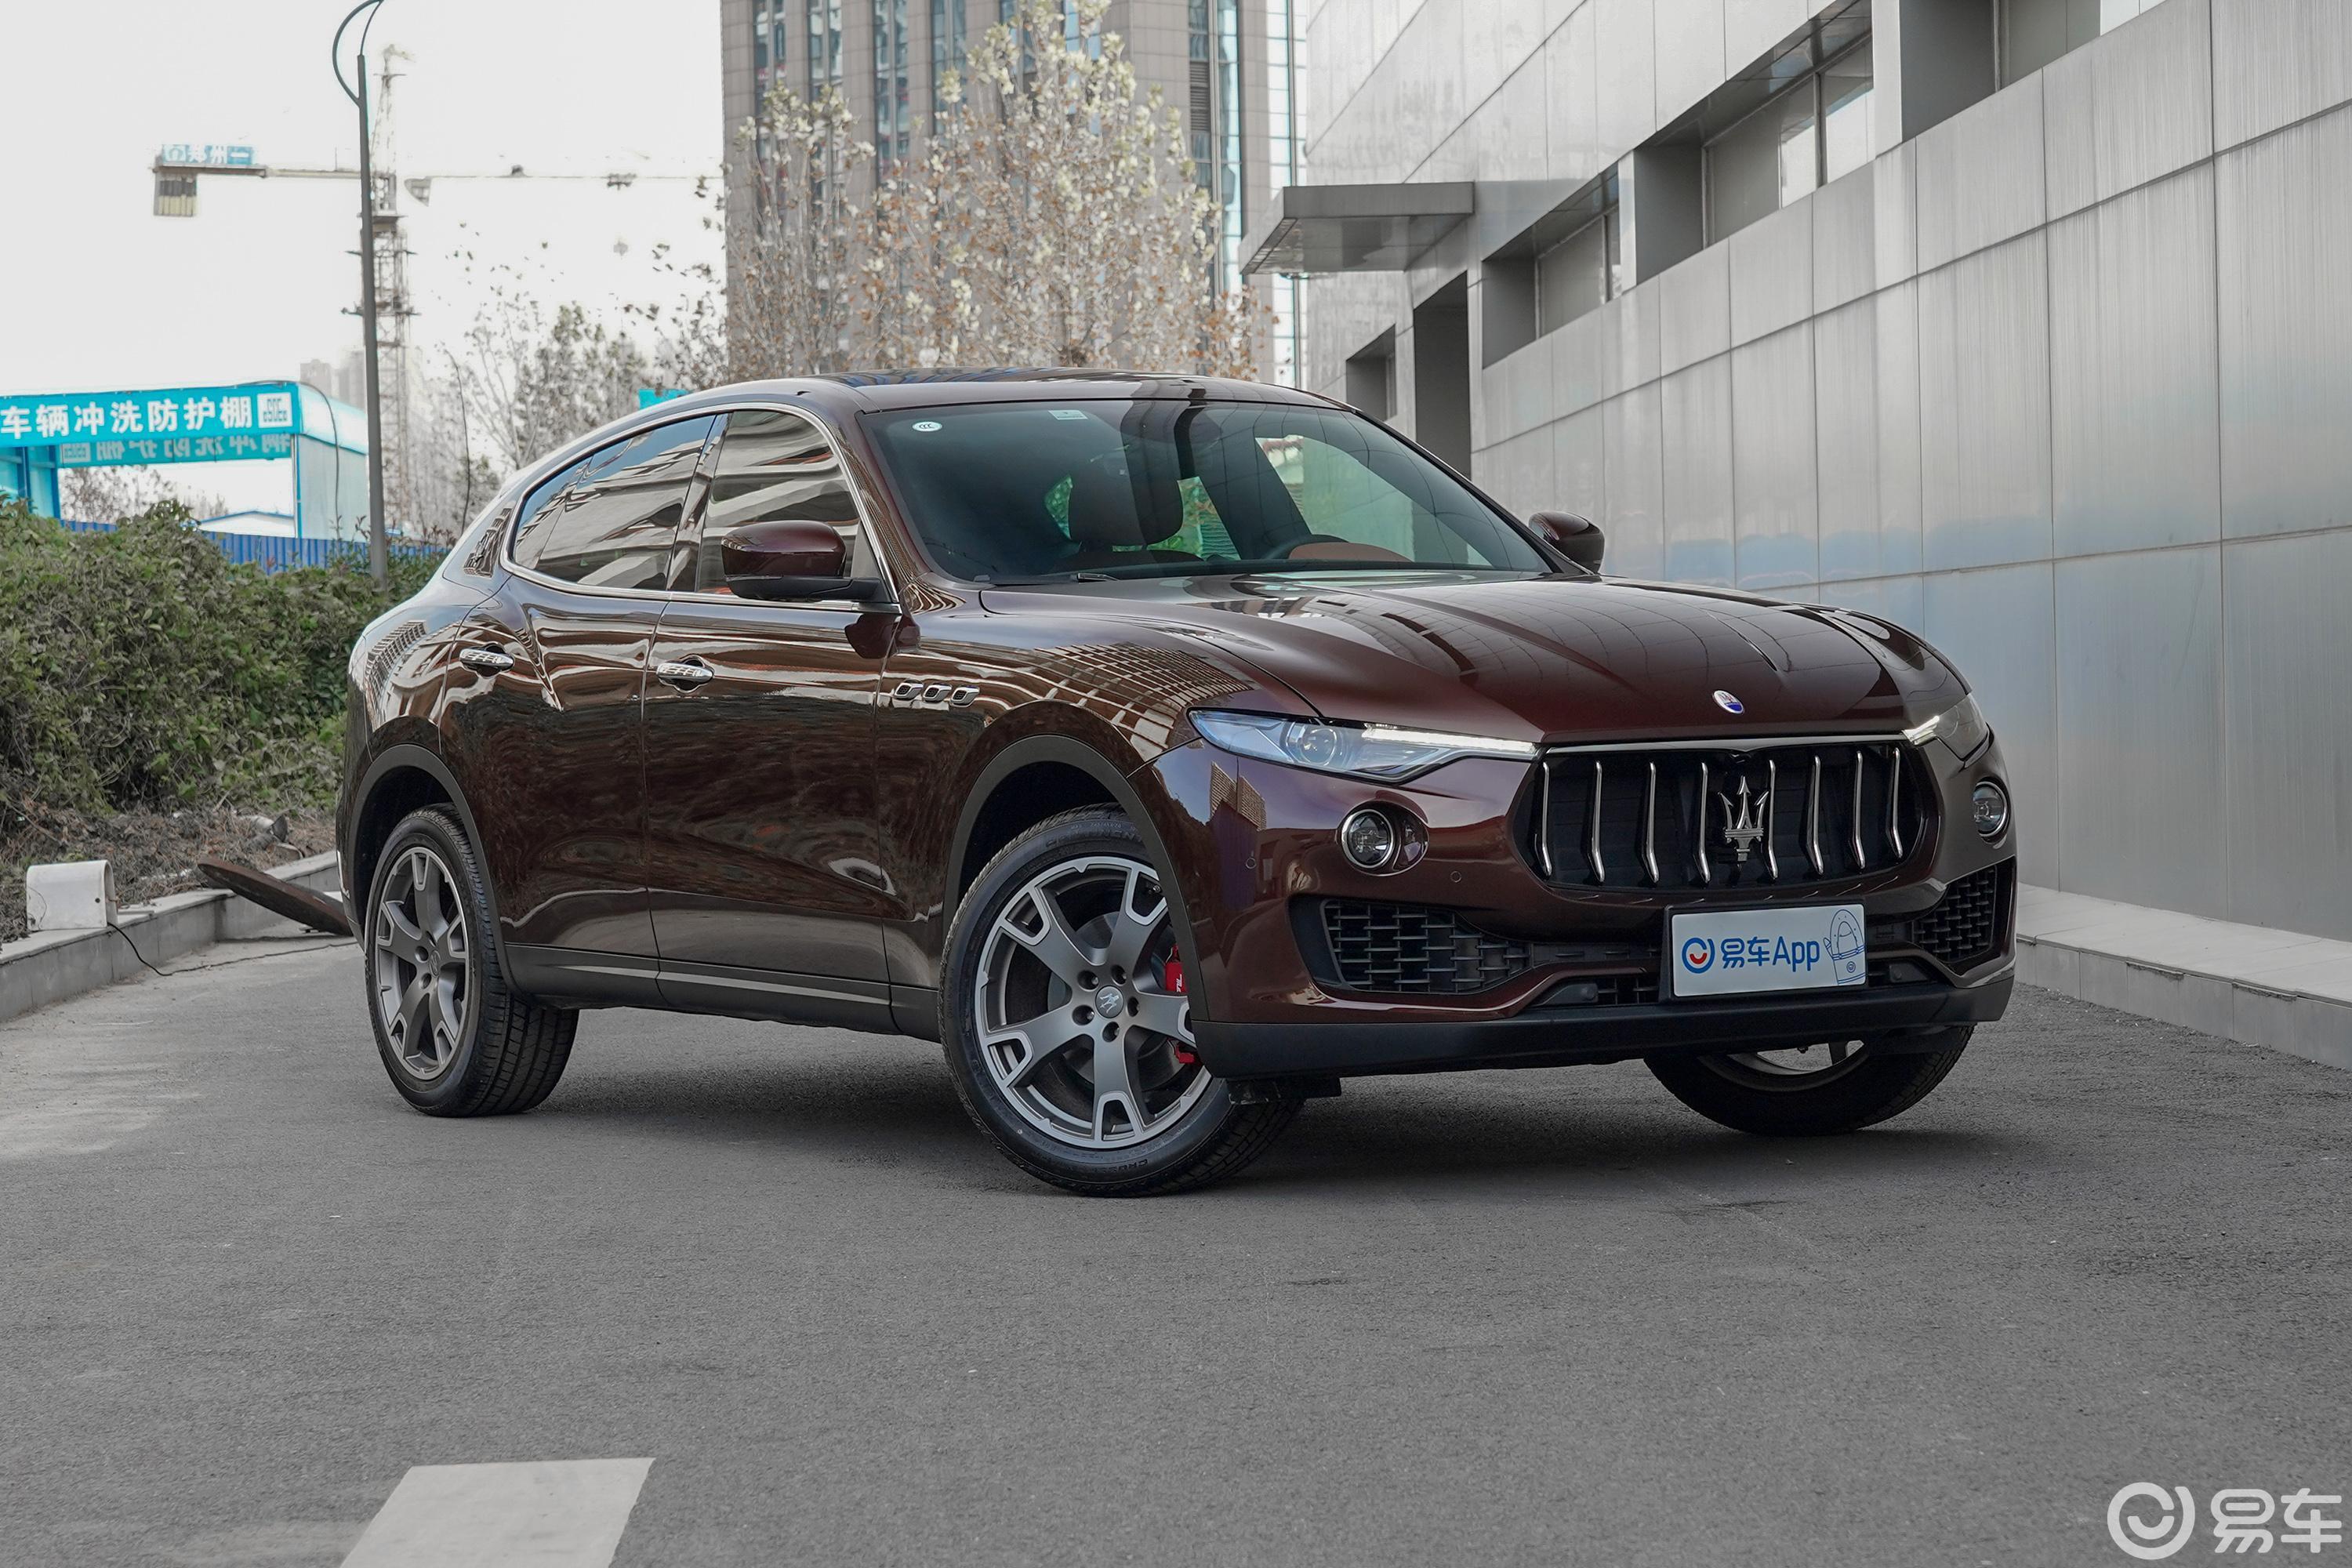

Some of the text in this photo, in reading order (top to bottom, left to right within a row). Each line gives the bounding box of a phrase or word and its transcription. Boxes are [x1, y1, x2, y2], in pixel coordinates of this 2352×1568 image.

[0, 396, 252, 440] 车辆冲洗防护棚
[1721, 936, 1820, 972] 易车App
